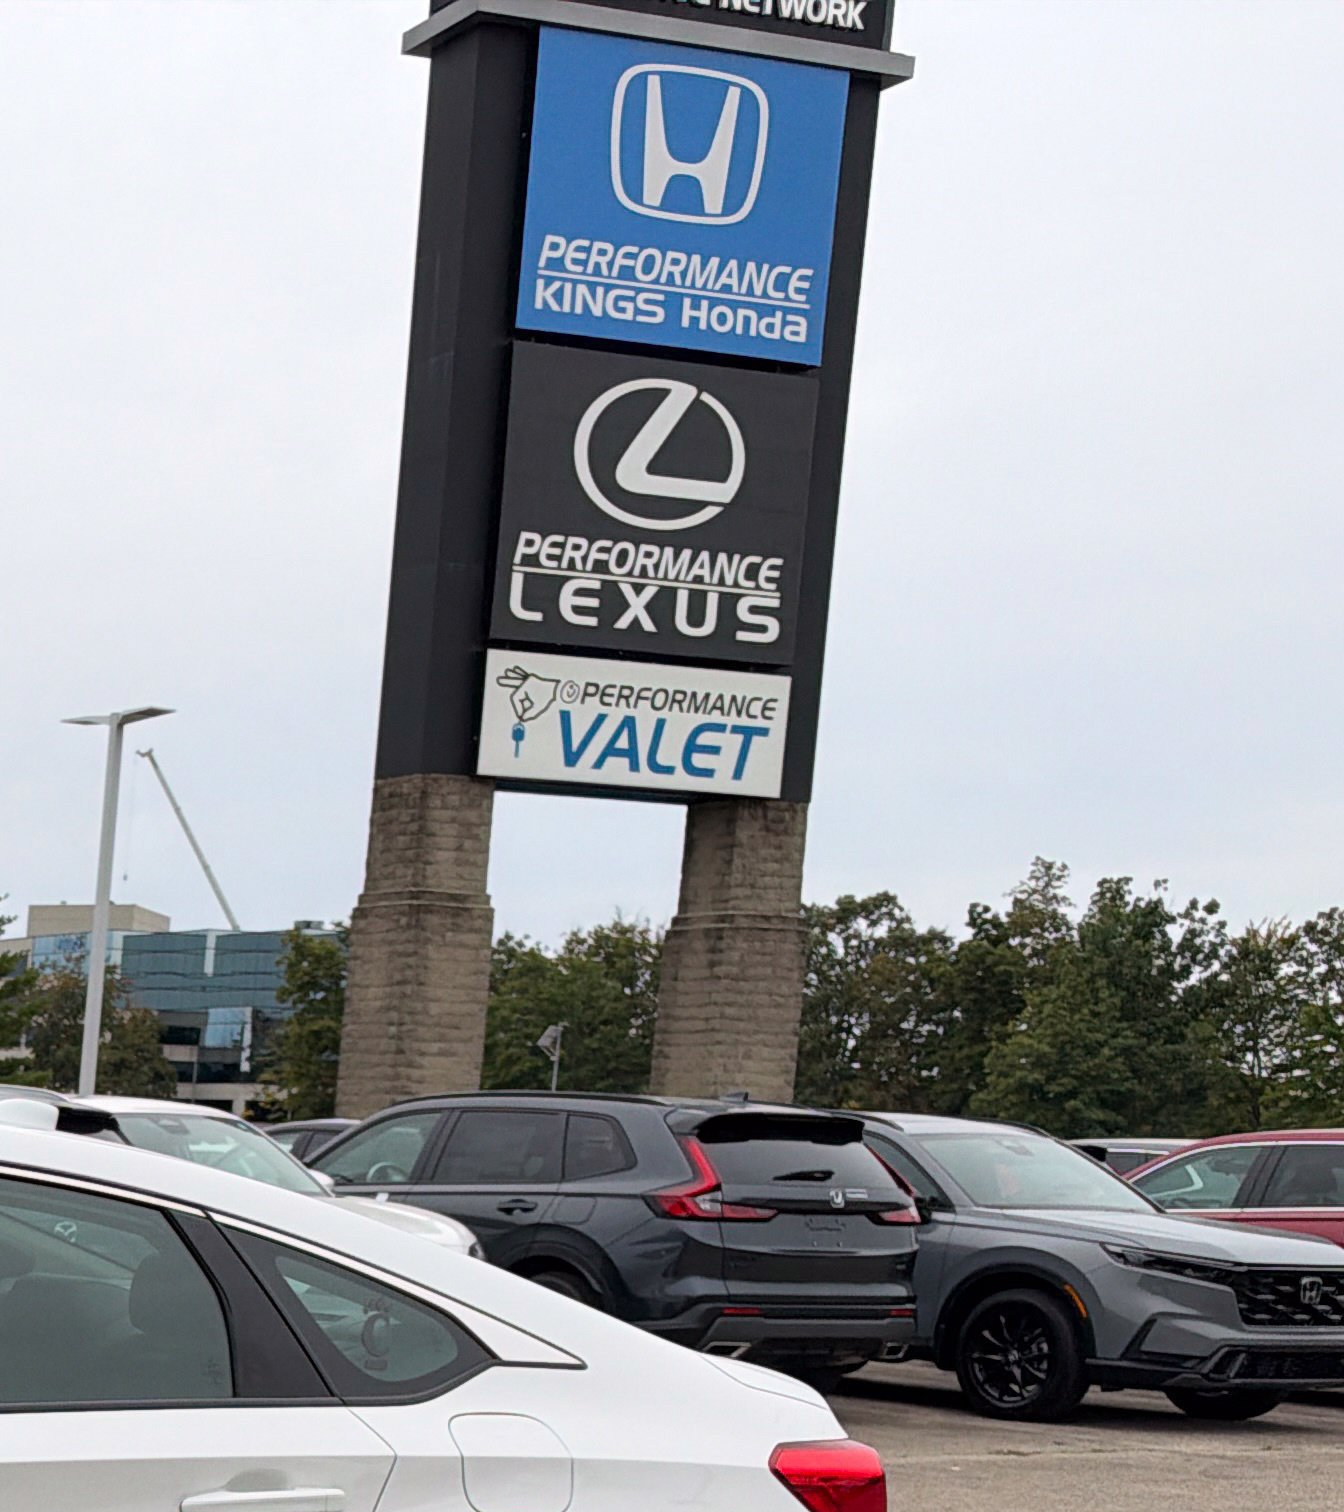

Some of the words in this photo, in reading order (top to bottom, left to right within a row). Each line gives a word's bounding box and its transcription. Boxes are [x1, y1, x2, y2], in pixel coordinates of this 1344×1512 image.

[538, 234, 814, 302] PERFORMANCE
[534, 278, 665, 324] KINGS
[681, 297, 808, 343] Honda
[513, 530, 784, 591] PERFORMANCE
[509, 572, 781, 644] LEXUS
[580, 682, 779, 721] PERFORMANCE
[559, 709, 771, 782] VALET
